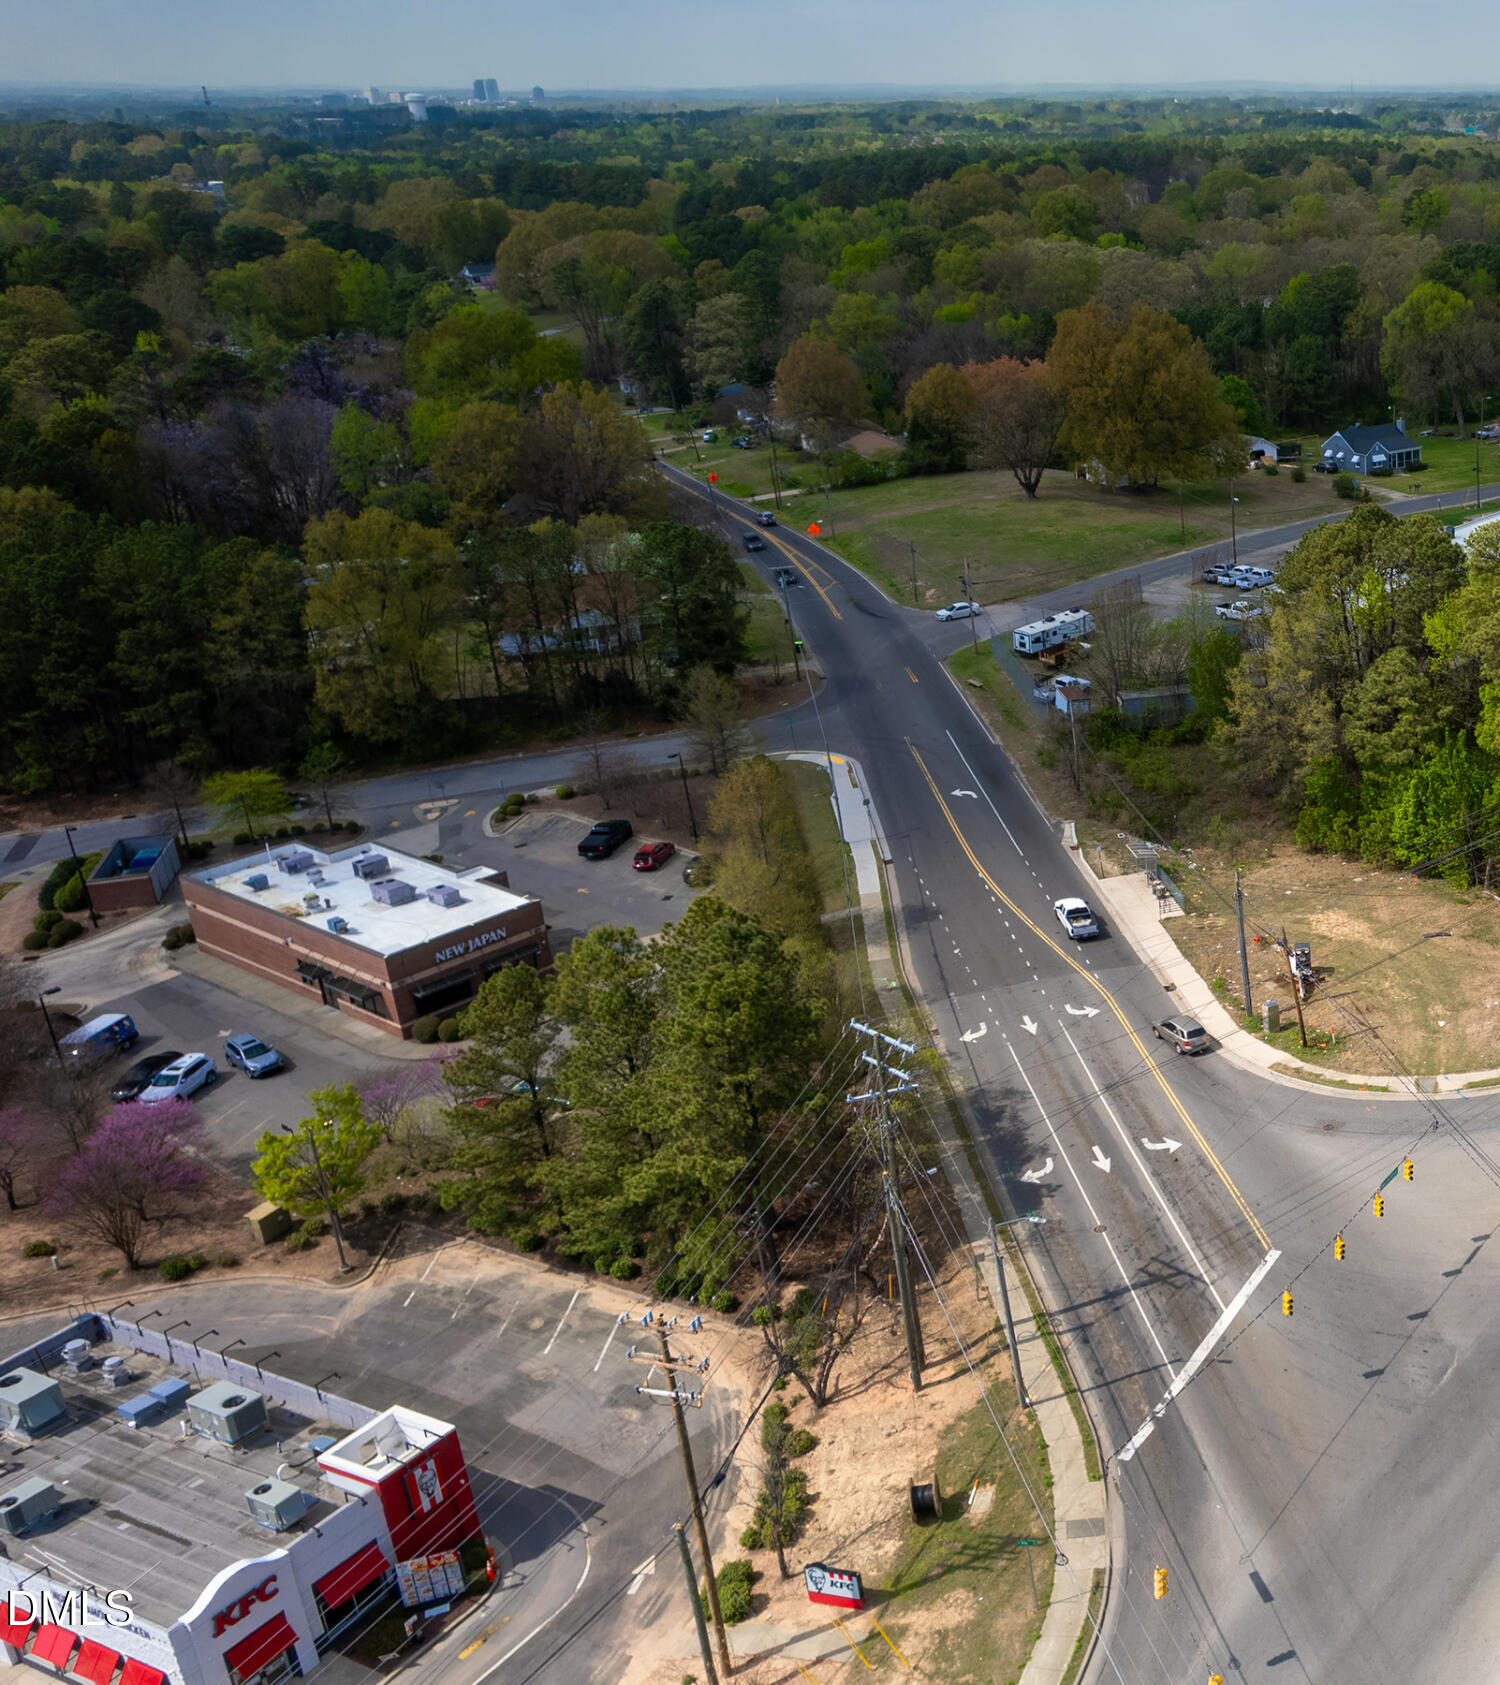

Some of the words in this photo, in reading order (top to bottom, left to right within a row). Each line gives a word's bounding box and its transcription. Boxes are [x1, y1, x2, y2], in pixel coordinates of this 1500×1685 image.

[435, 942, 465, 963] NEW
[467, 927, 507, 953] JAPAN
[830, 1580, 855, 1591] KFC
[212, 1574, 279, 1638] KFC
